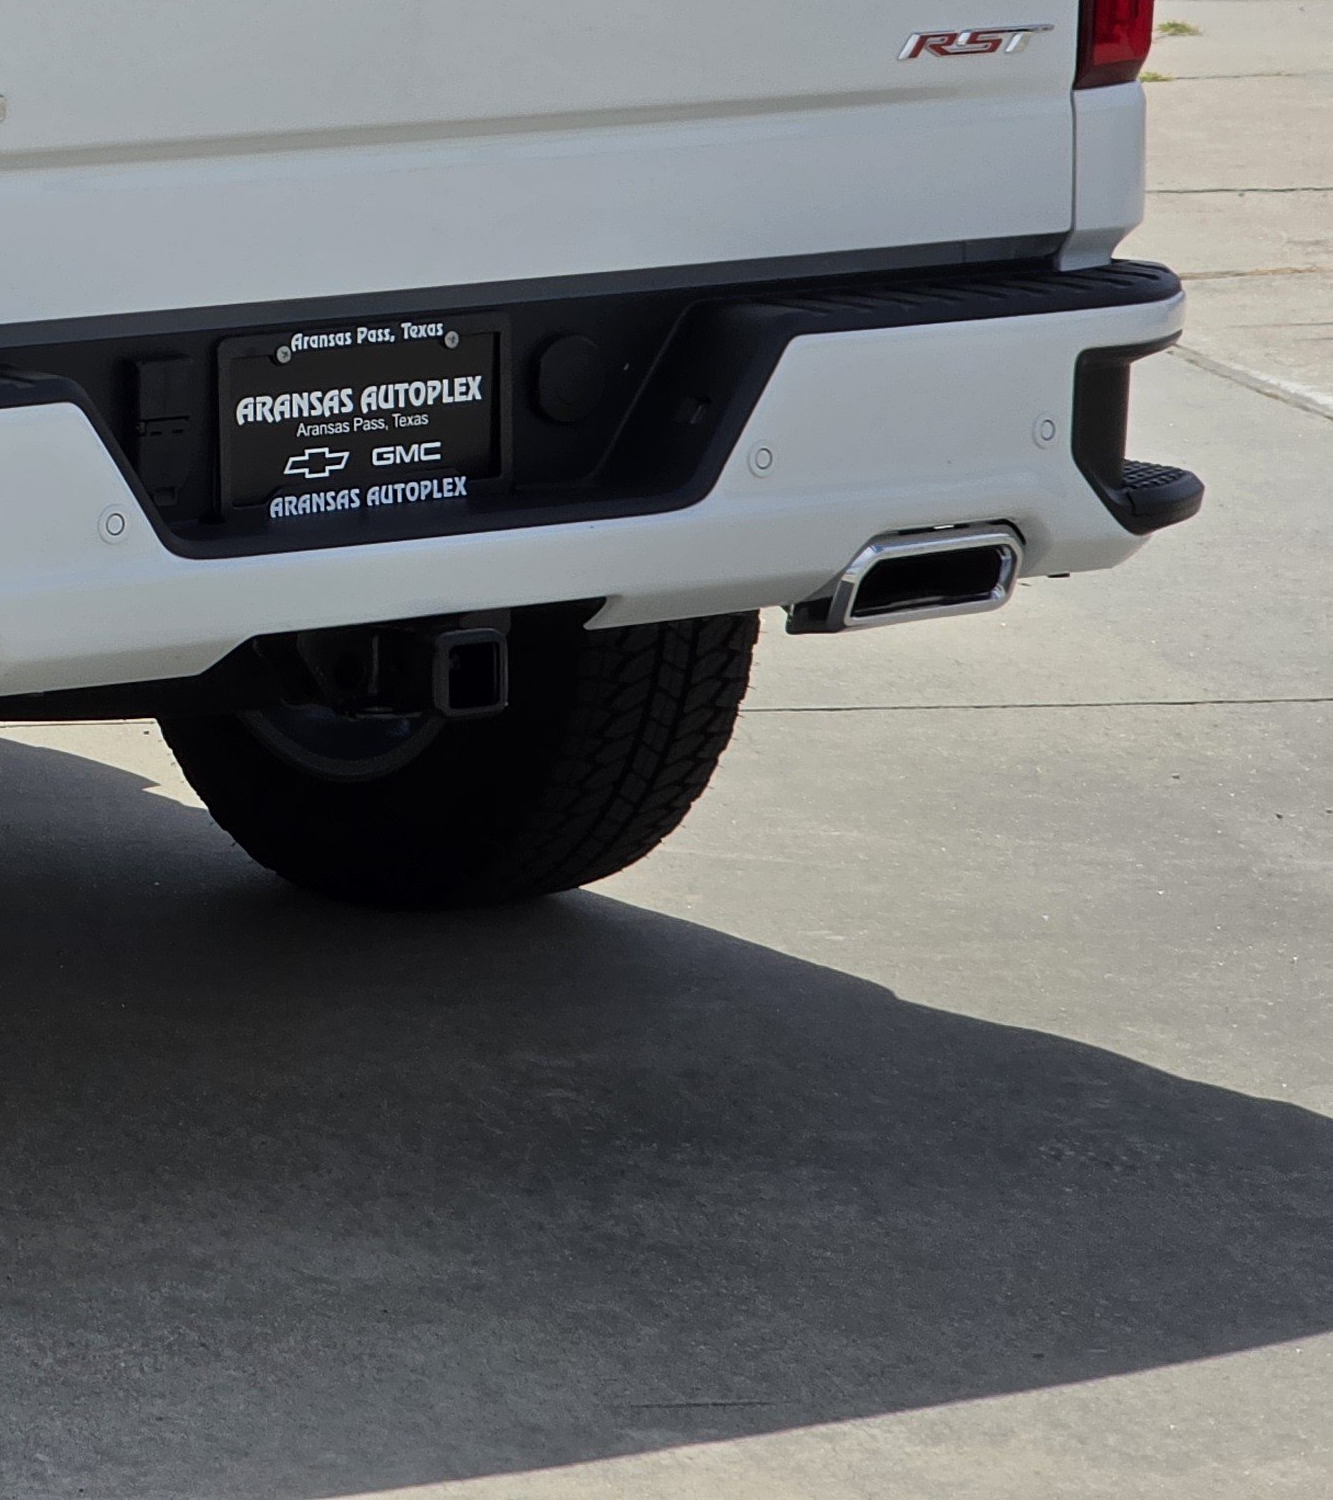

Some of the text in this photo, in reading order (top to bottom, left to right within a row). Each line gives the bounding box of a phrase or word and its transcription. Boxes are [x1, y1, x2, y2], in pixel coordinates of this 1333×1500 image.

[897, 24, 1055, 61] RST
[290, 321, 444, 352] Aransas Pass, Texas
[235, 375, 483, 426] ARANSAS AUTOPLEX
[296, 412, 430, 438] Aransas Pass, Texas
[371, 441, 442, 467] GMC
[268, 475, 468, 520] ARANSAS AUTOPLEX
